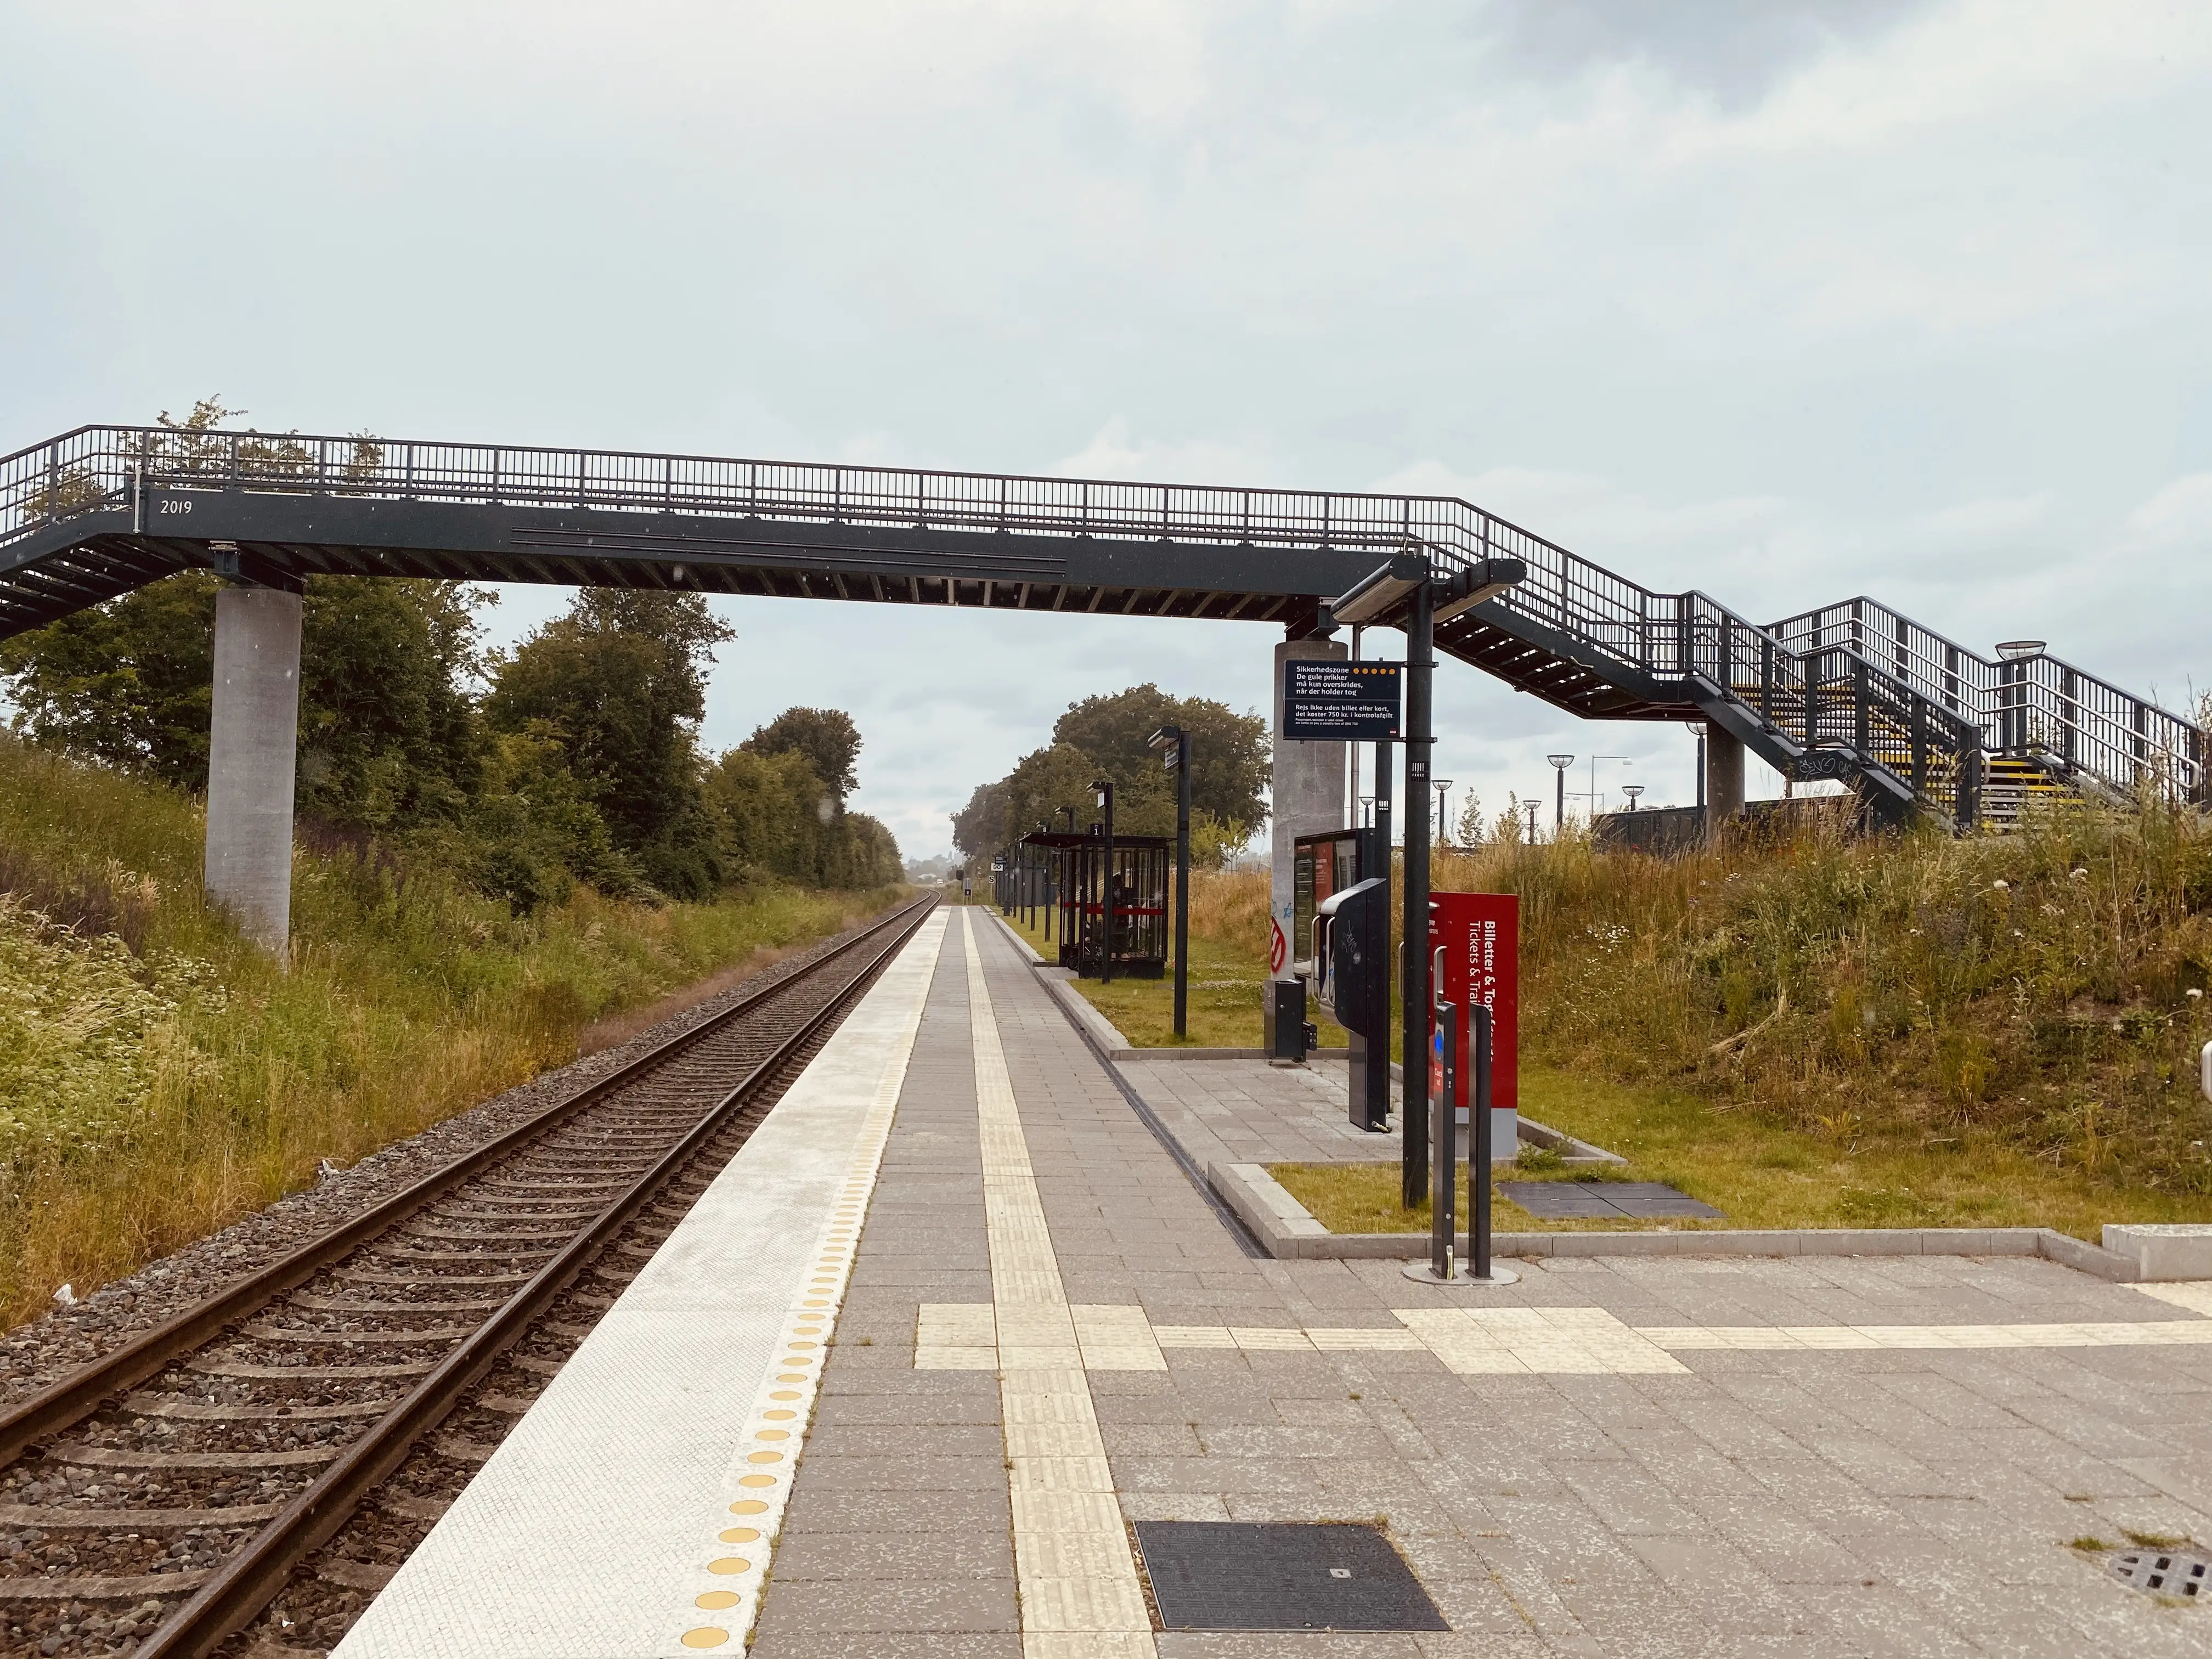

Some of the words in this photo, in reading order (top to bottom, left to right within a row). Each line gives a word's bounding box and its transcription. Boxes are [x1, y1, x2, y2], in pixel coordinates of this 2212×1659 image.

[160, 500, 192, 514] 2019
[1469, 920, 1481, 964] Tickets
[1484, 921, 1496, 972] Billetter
[1469, 967, 1480, 977] &
[1484, 975, 1496, 986] &
[1469, 980, 1481, 1003] Trai
